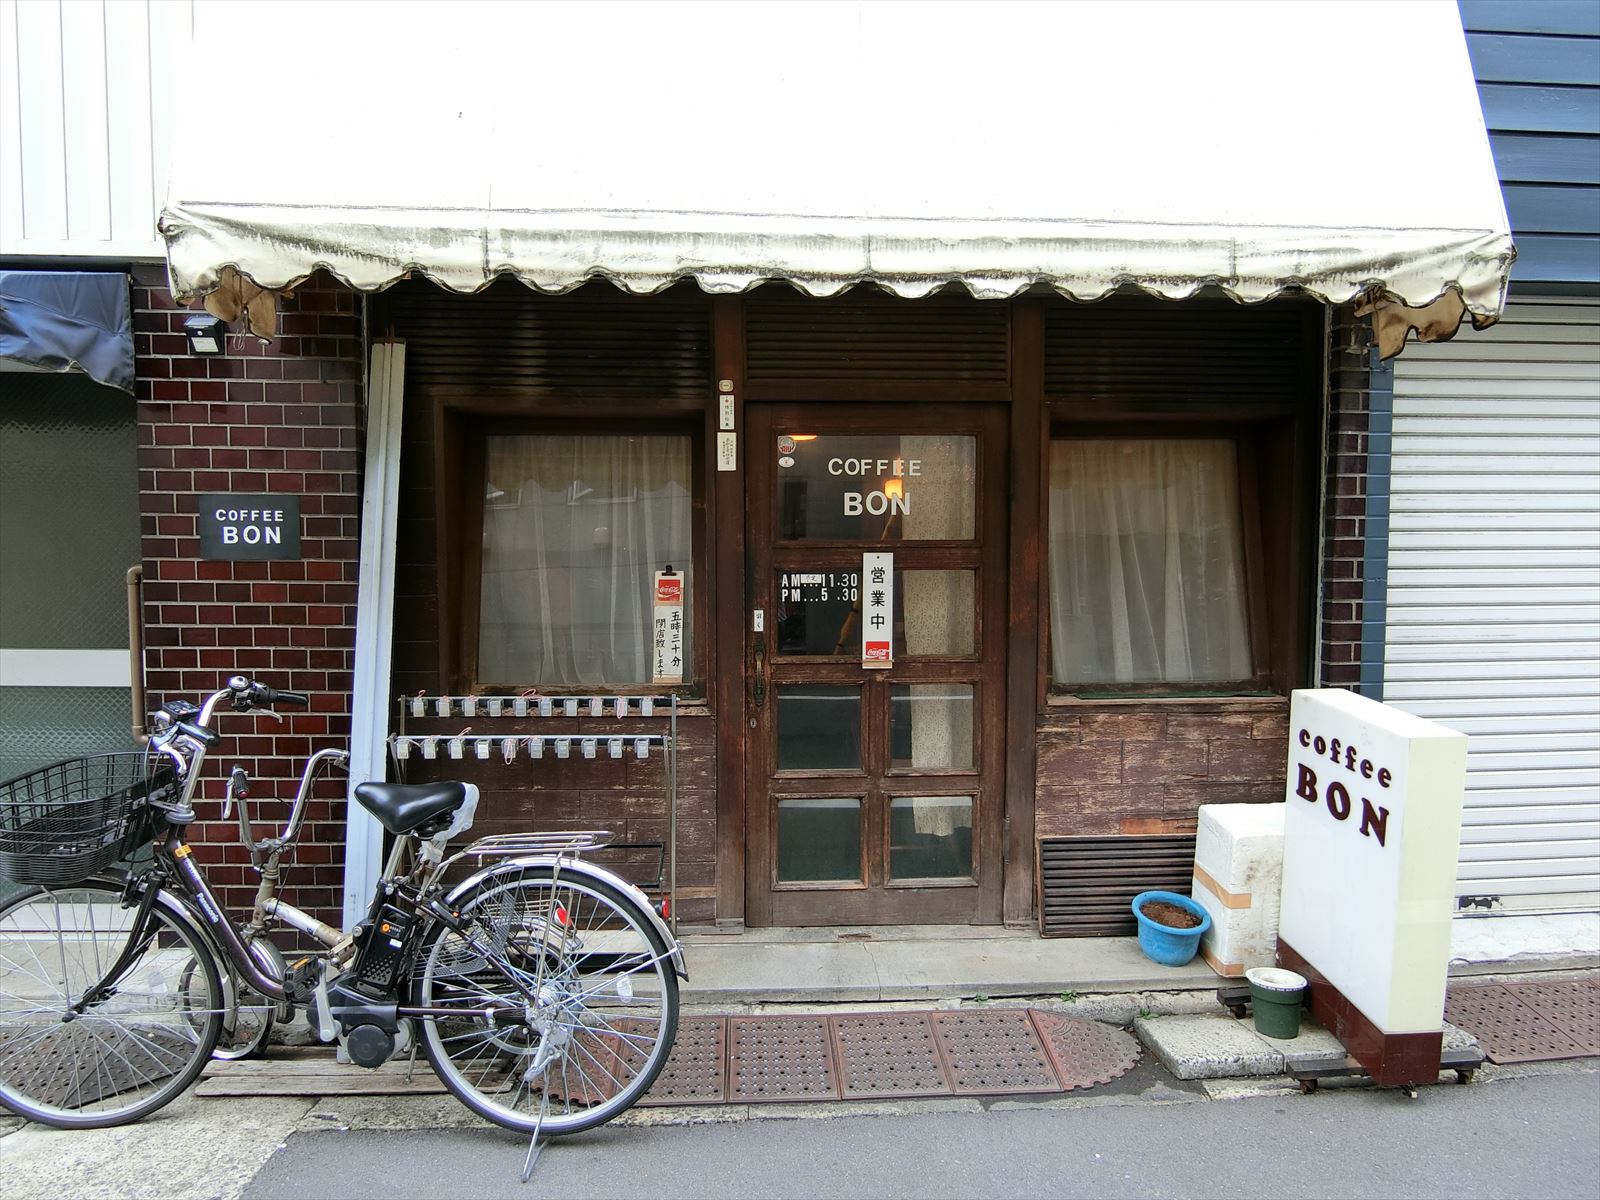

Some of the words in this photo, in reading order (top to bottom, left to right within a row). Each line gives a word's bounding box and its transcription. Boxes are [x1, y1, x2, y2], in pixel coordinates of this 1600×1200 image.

[827, 457, 922, 476] COFFEE
[215, 508, 284, 522] COFFEE
[843, 490, 911, 517] BON
[222, 525, 281, 545] BON
[870, 566, 886, 631] 営業中
[1299, 728, 1392, 788] coffee
[1296, 762, 1390, 848] BON
